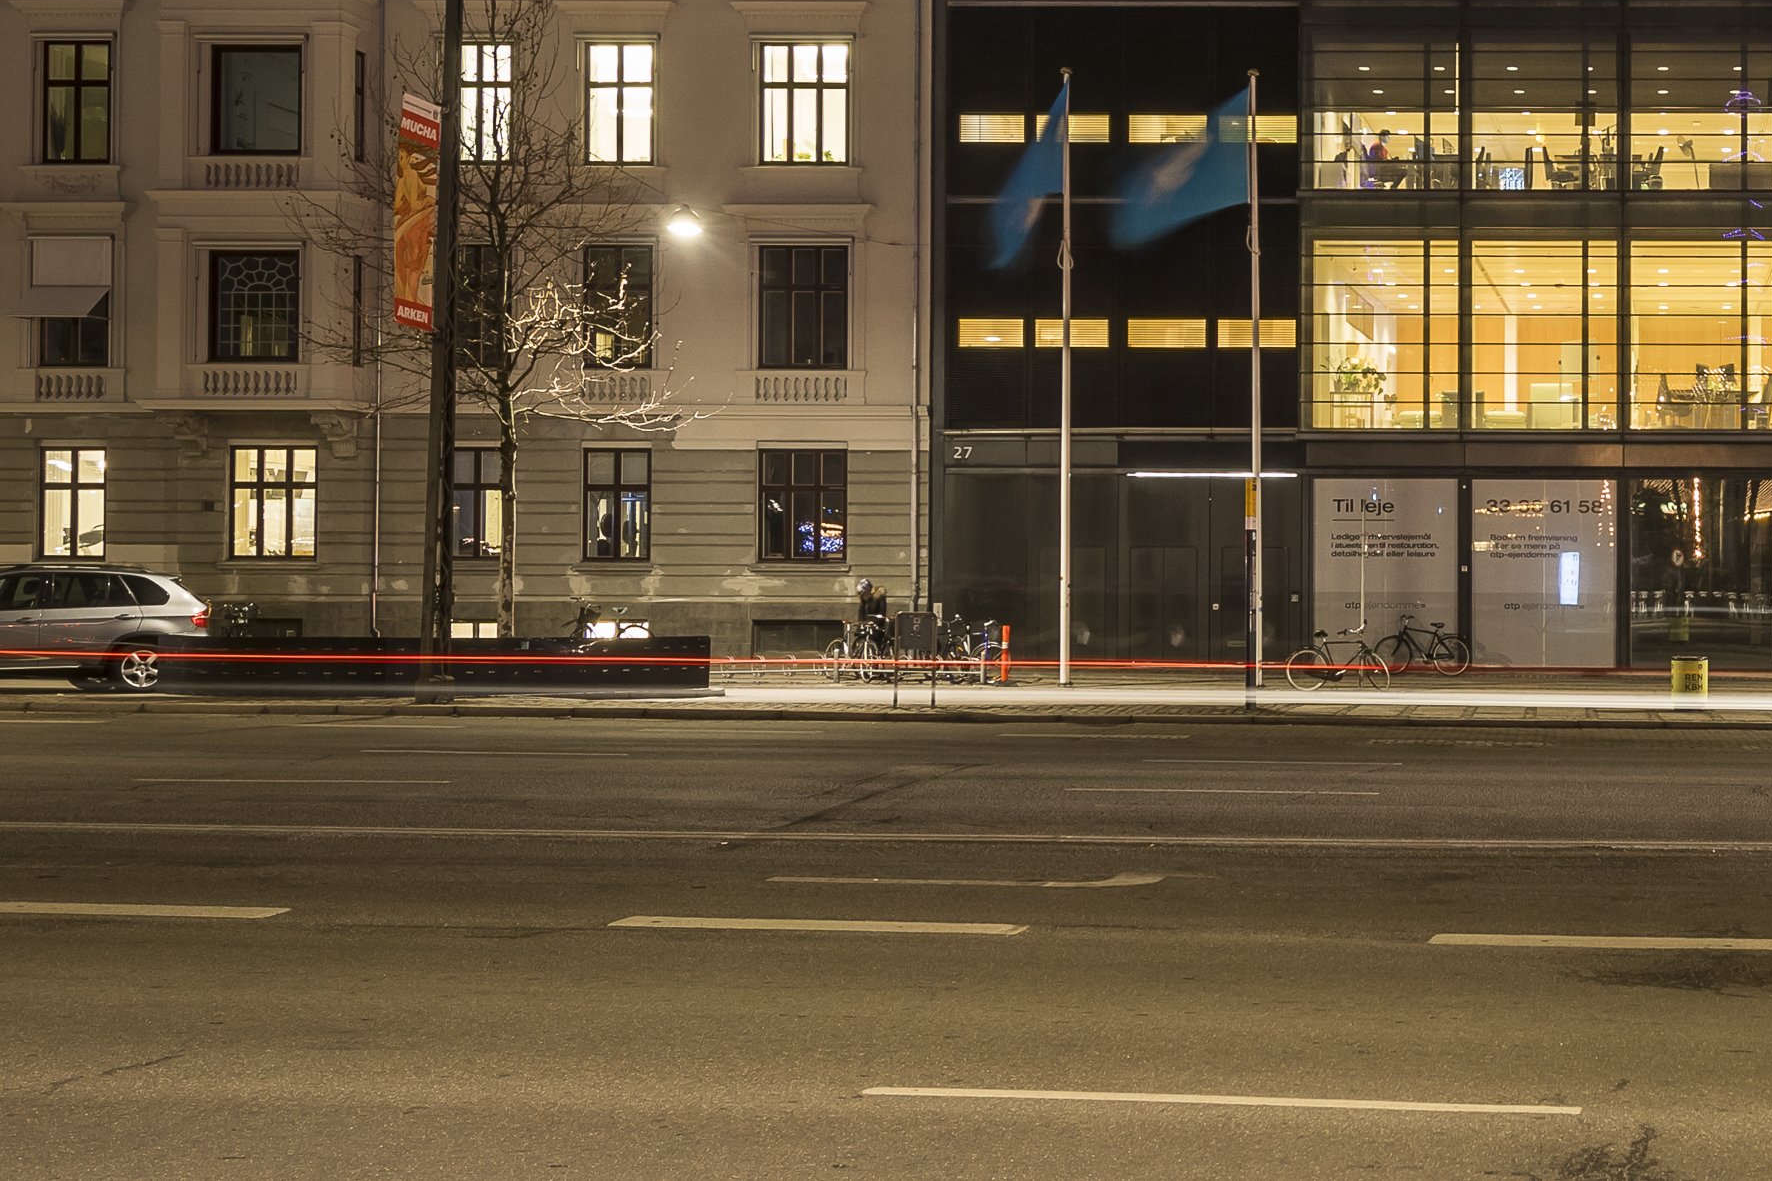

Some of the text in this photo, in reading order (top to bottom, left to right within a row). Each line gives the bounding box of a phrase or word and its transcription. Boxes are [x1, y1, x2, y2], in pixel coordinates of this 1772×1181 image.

[401, 117, 437, 141] MUCHA
[397, 305, 428, 324] ARKEN
[953, 446, 973, 459] 27
[1332, 499, 1395, 516] Til leje
[1486, 499, 1511, 513] 33
[1550, 500, 1570, 514] 61
[1578, 500, 1603, 514] 58
[1331, 533, 1432, 542] Ledige rhvervslejemål
[1528, 534, 1578, 543] fremvisning
[1549, 542, 1561, 551] på
[1331, 550, 1384, 558] detailhndel
[1344, 601, 1361, 610] atp
[1504, 602, 1521, 611] atp
[1684, 673, 1703, 681] REN
[1684, 683, 1703, 691] KBH
